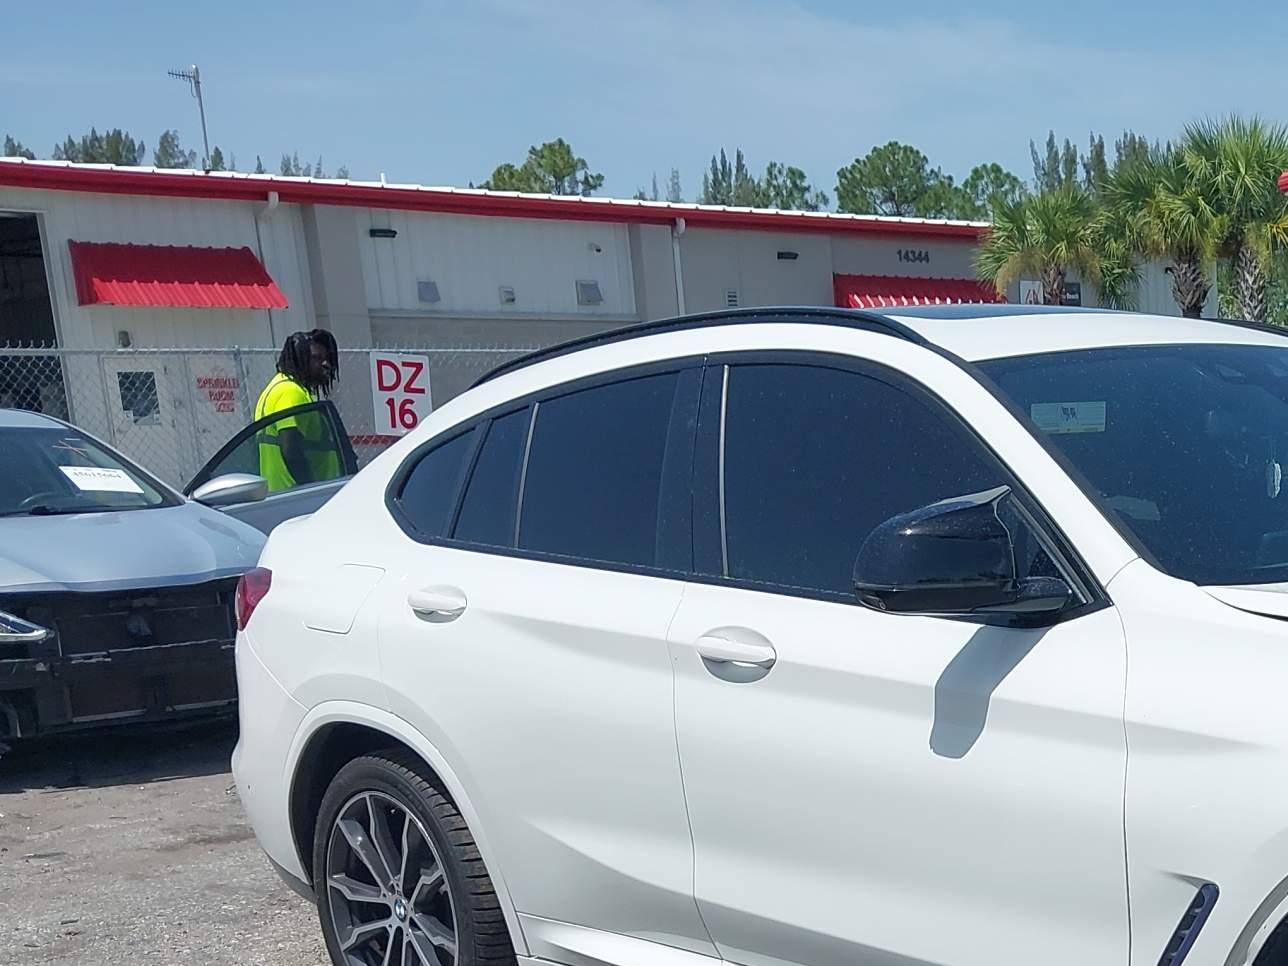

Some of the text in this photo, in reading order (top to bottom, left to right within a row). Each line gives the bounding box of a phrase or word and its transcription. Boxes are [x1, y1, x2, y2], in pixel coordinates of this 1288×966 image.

[897, 249, 930, 263] 14344
[376, 359, 426, 394] DZ
[385, 397, 418, 429] 16
